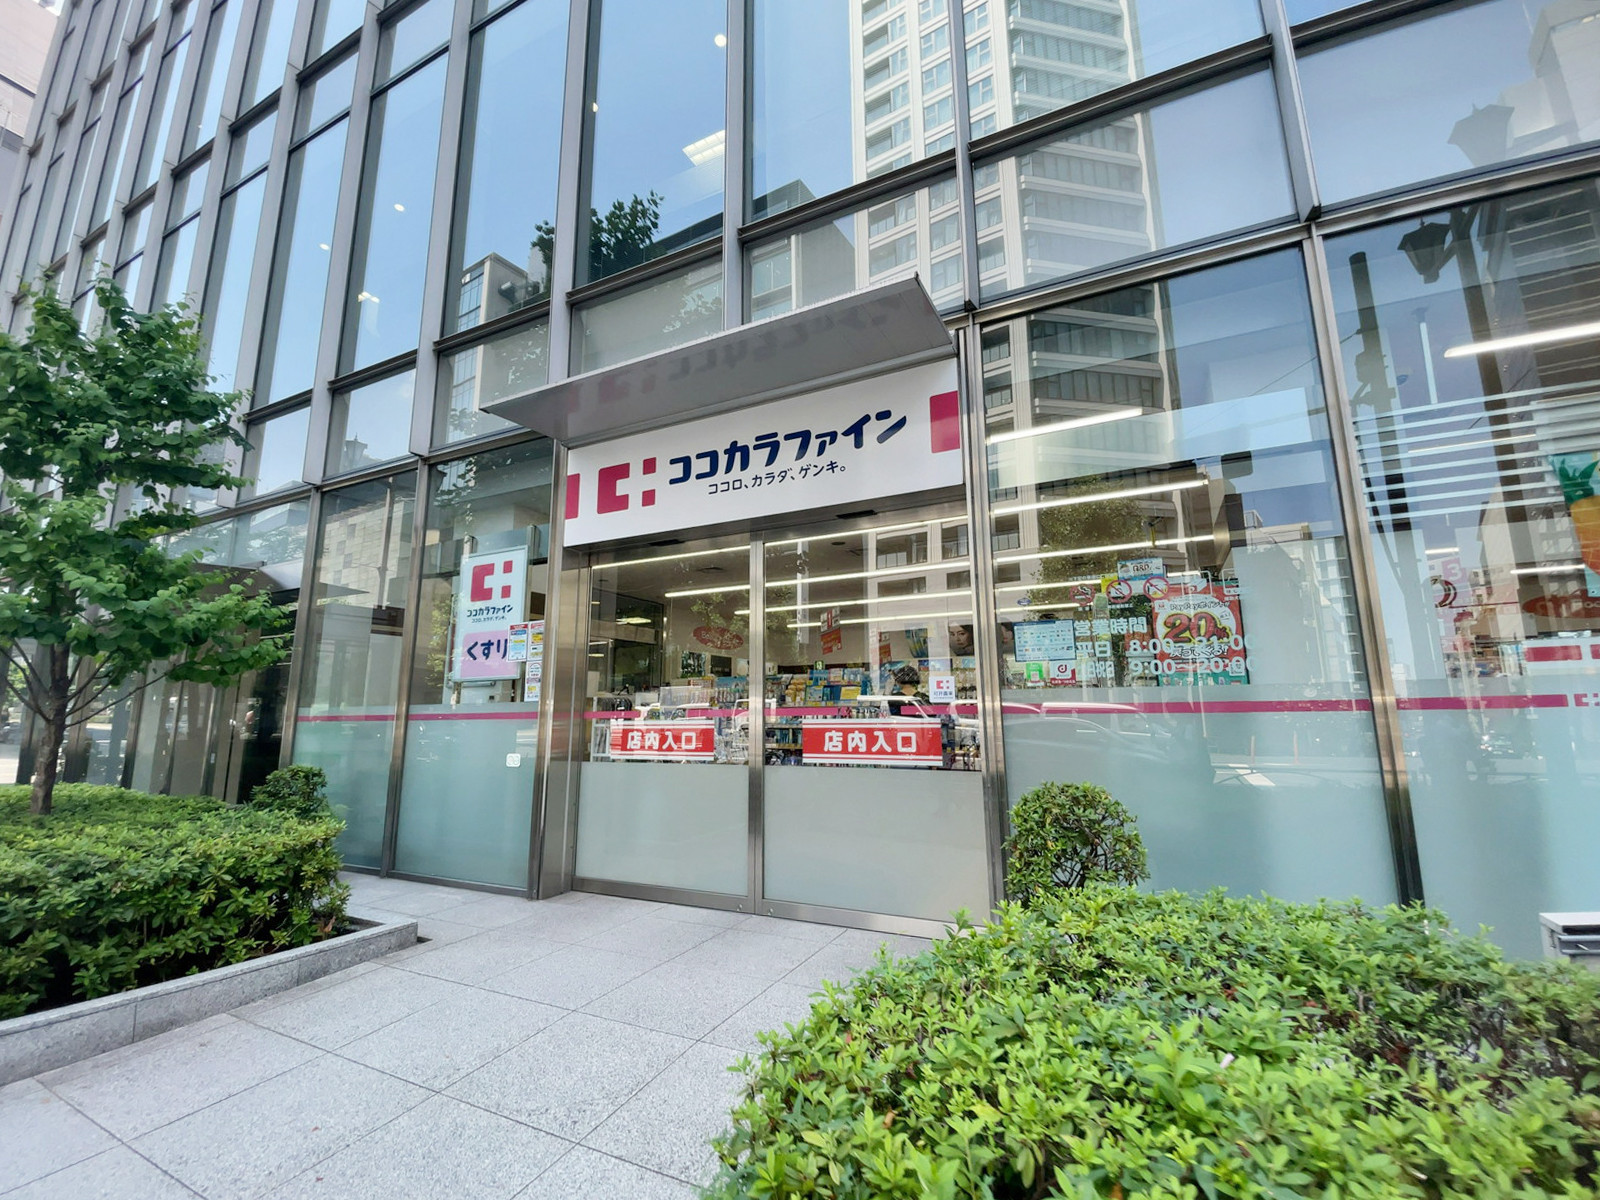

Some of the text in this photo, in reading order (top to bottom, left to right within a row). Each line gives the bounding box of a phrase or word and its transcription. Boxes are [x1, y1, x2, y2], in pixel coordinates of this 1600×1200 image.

[668, 409, 907, 485] ココカラファイン
[707, 460, 847, 496] ココロ、カラダ、ゲンキ。
[467, 604, 513, 617] ココカラファイン
[1073, 616, 1148, 637] 営業時間
[467, 640, 508, 660] くすり
[626, 731, 698, 751] 店内入口
[823, 730, 918, 753] 店内入口
